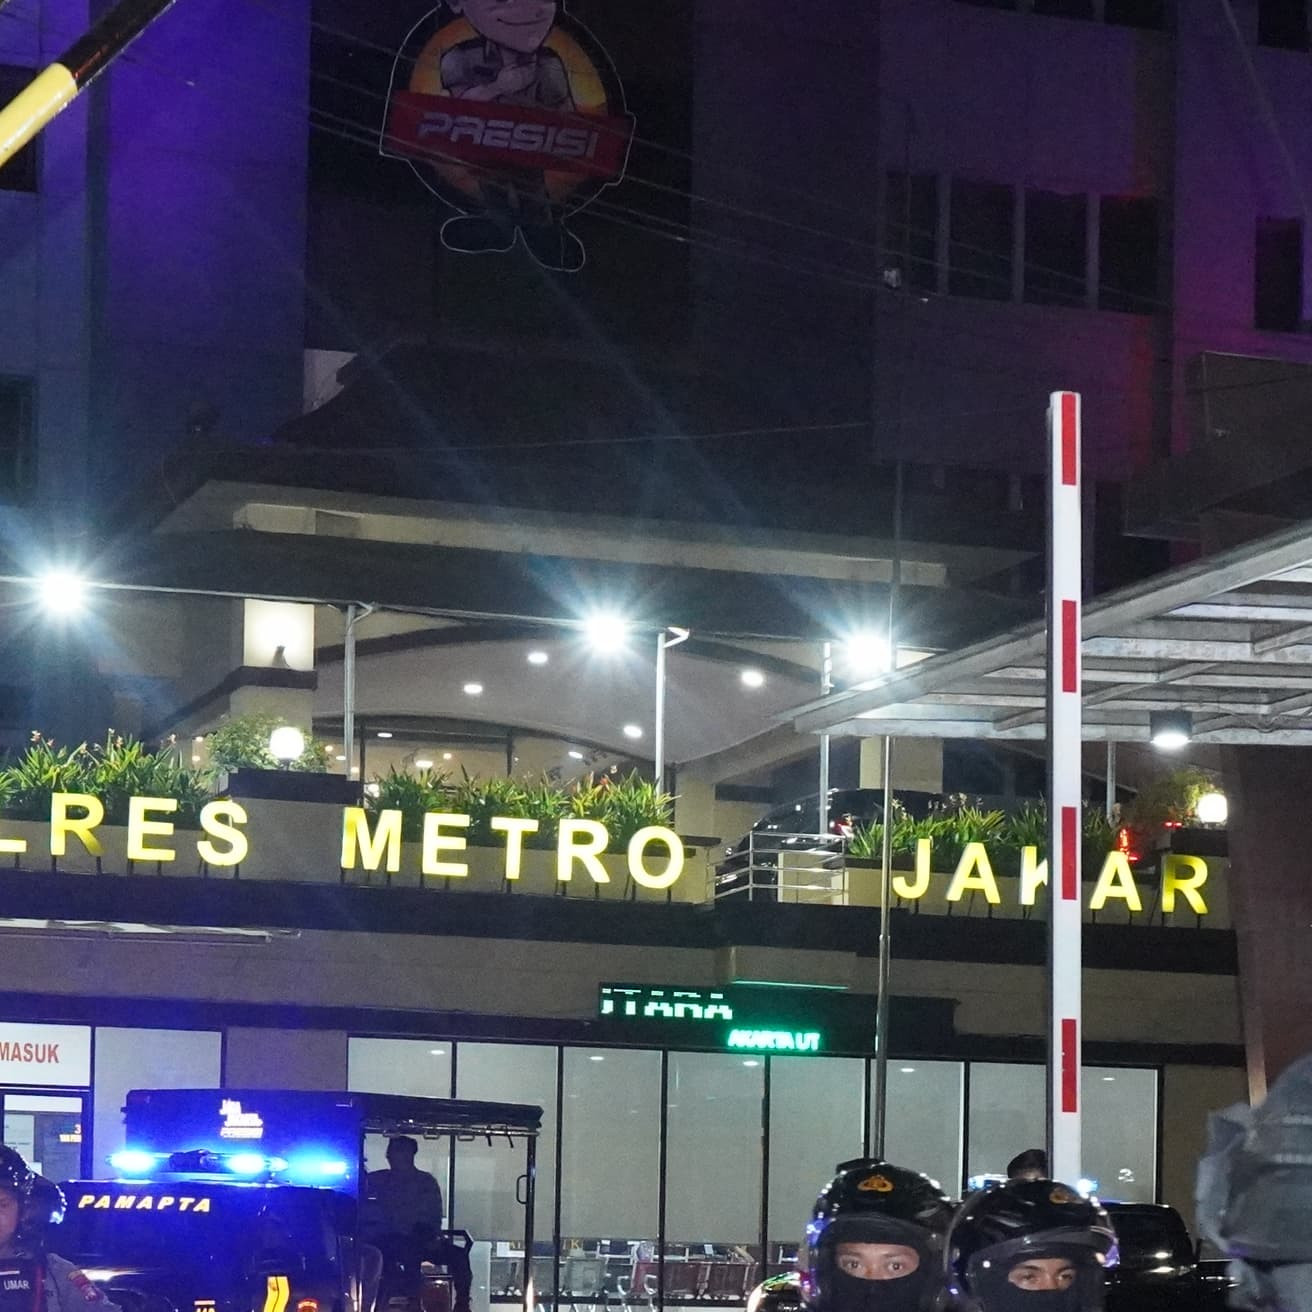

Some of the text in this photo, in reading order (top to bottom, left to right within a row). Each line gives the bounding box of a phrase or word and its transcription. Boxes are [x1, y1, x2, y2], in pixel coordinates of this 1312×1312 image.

[418, 111, 600, 158] PRESISI
[340, 806, 685, 891] METRO
[78, 1194, 211, 1213] PAMAPTA
[3, 1278, 30, 1291] UMAR
